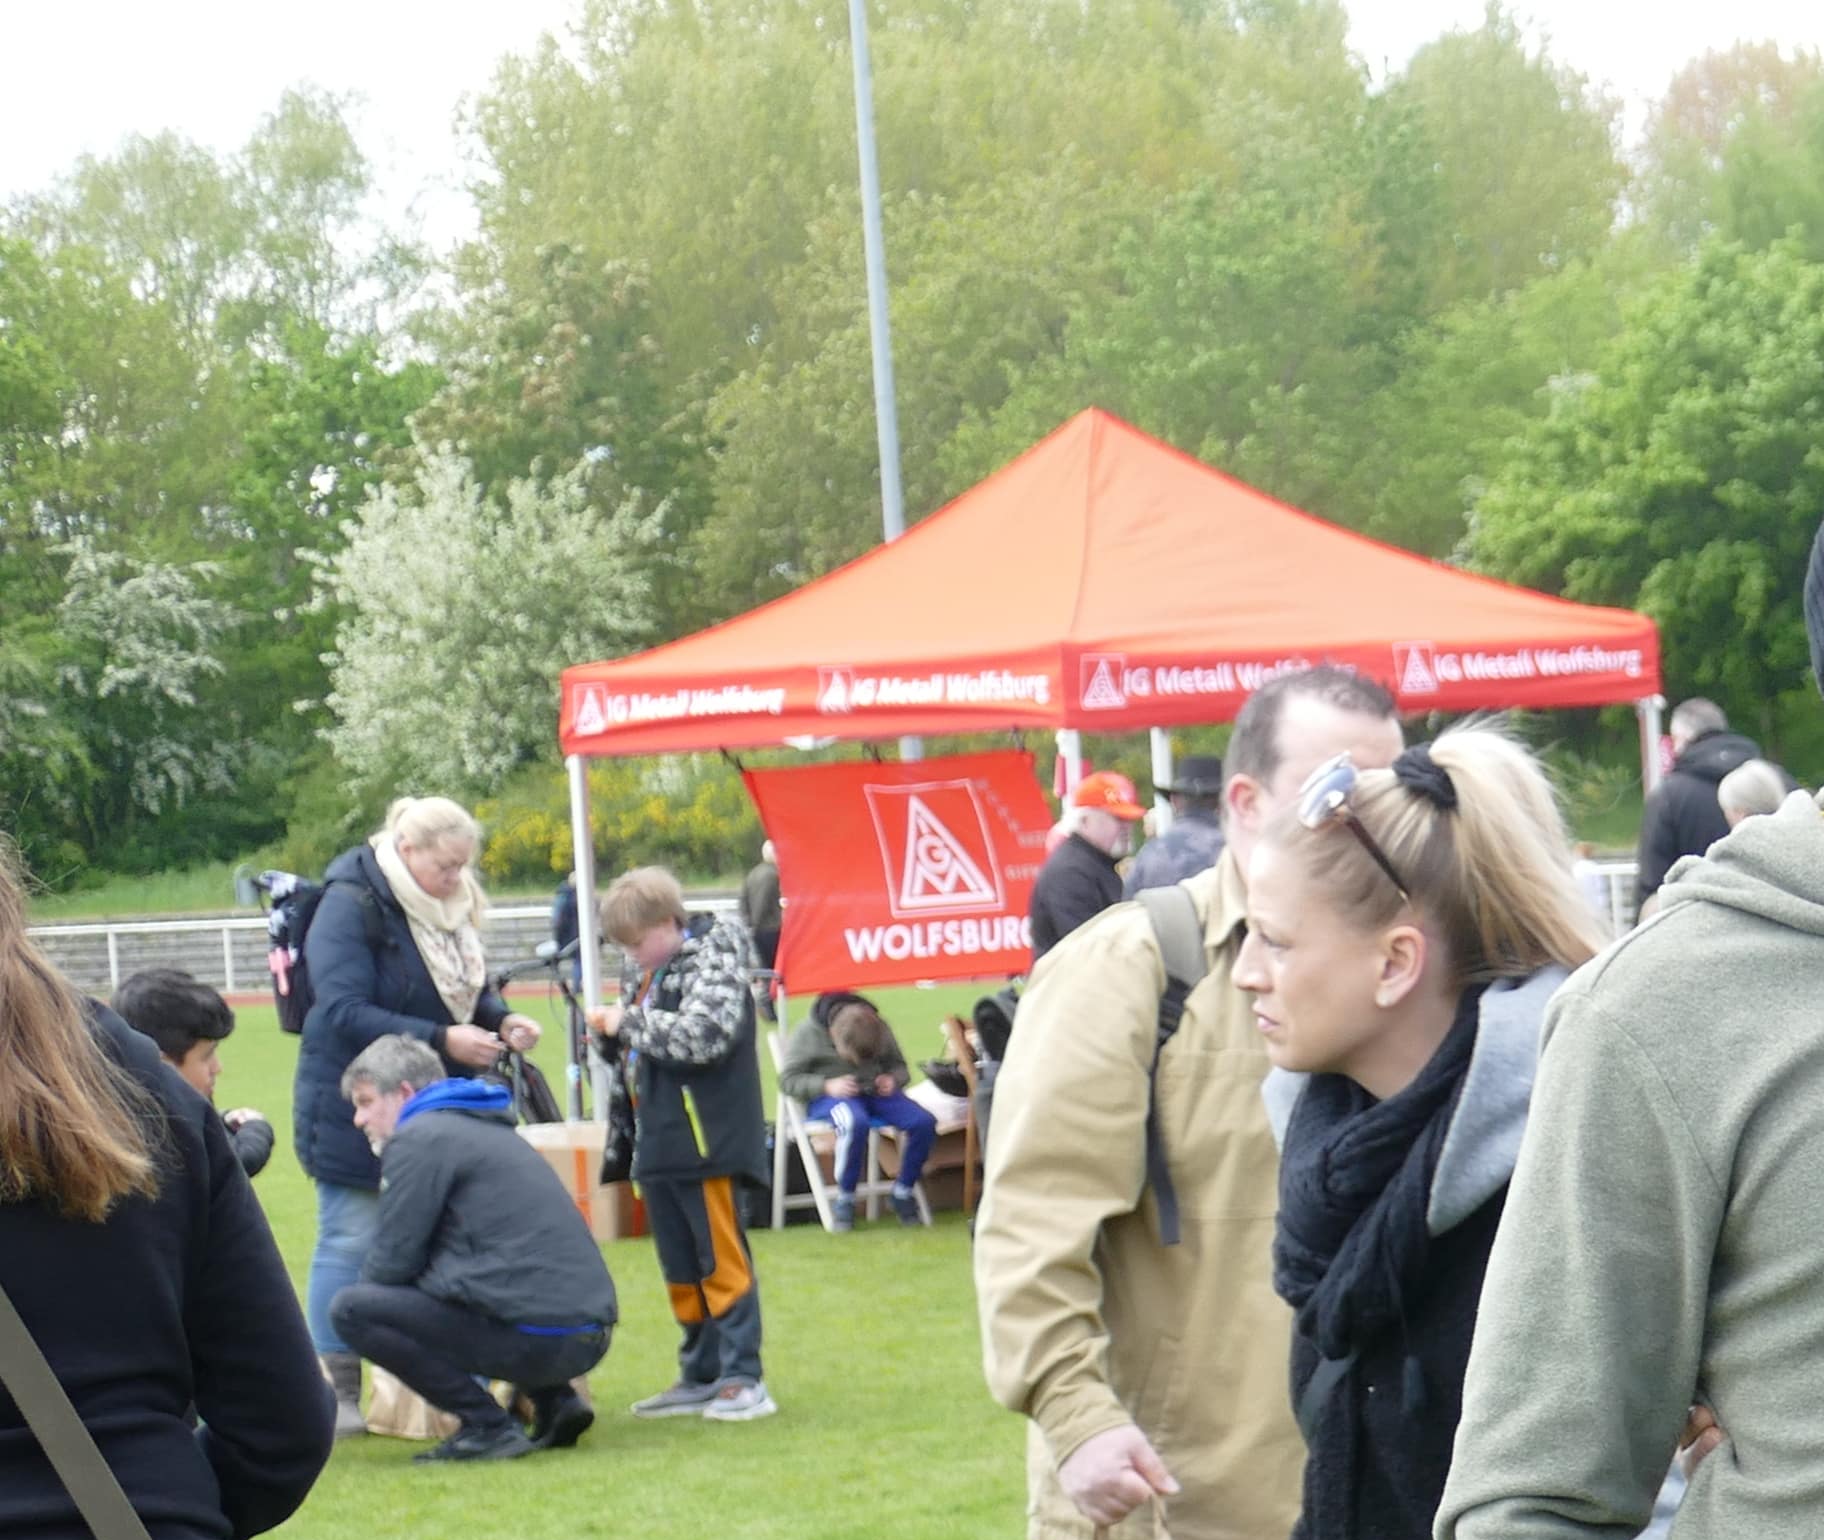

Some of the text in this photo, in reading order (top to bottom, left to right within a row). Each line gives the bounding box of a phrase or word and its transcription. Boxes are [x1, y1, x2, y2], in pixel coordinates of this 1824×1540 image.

[1123, 667, 1150, 697] IG
[1155, 661, 1237, 694] Metall
[1435, 645, 1641, 682] IG Metall Wolfsburg
[607, 686, 785, 721] IG Metall Wolfsburg
[851, 671, 1049, 706] IG Metall Wolfsburg
